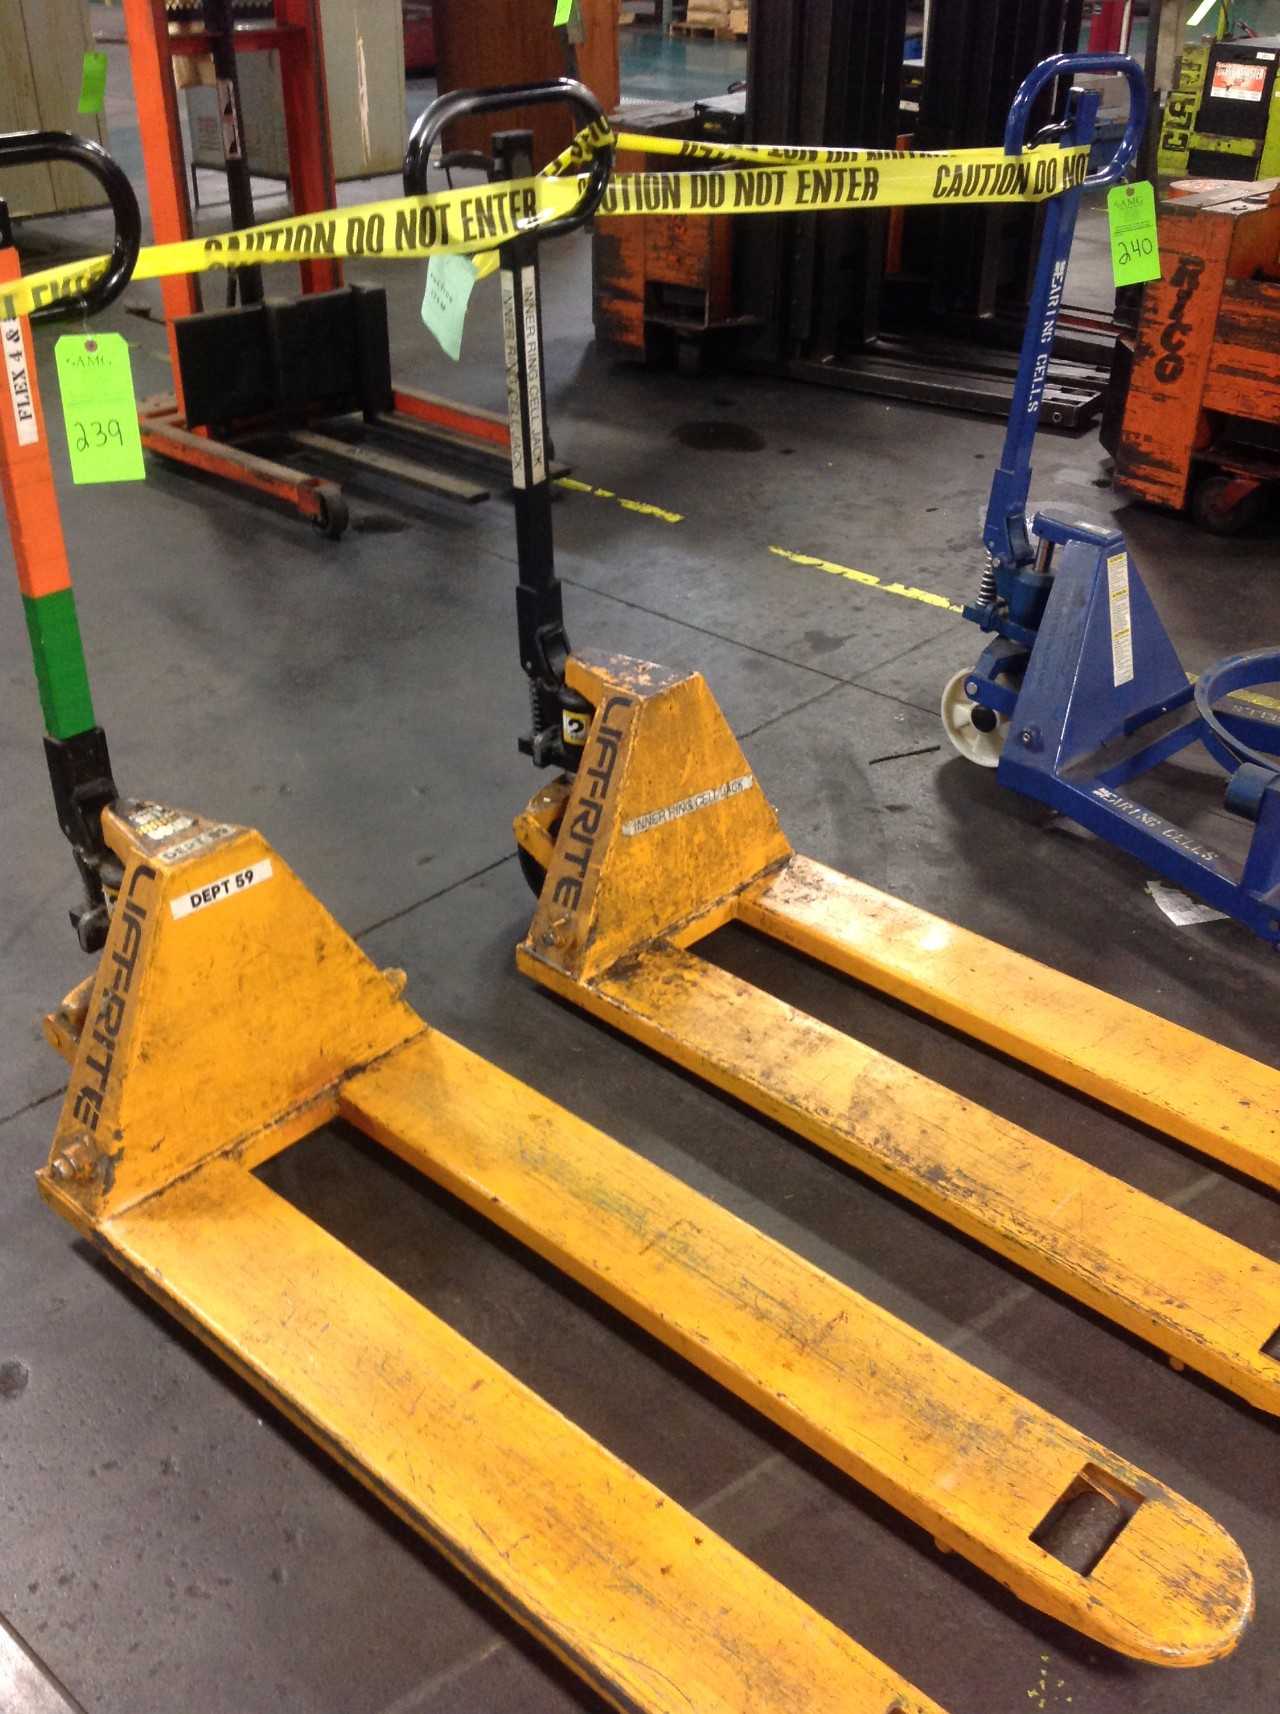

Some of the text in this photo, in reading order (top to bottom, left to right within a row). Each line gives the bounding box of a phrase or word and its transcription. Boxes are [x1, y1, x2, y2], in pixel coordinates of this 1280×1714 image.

[690, 171, 726, 209] DO
[734, 170, 789, 207] NOT
[795, 166, 880, 204] ENTER
[932, 161, 1031, 198] CAUTION
[1033, 157, 1058, 195] DO
[346, 214, 385, 257] DO
[395, 203, 452, 252] NOT
[1118, 238, 1154, 265] 240
[1154, 256, 1206, 384] RICO
[6, 329, 33, 422] FLEX 4 &
[524, 286, 544, 466] INNER RING CELL JACK
[1027, 353, 1048, 413] CELLS
[74, 419, 124, 452] 239
[552, 695, 632, 912] LIFT-RITE
[189, 870, 255, 909] DEPT 59
[73, 863, 157, 1132] LIFT-RITE
